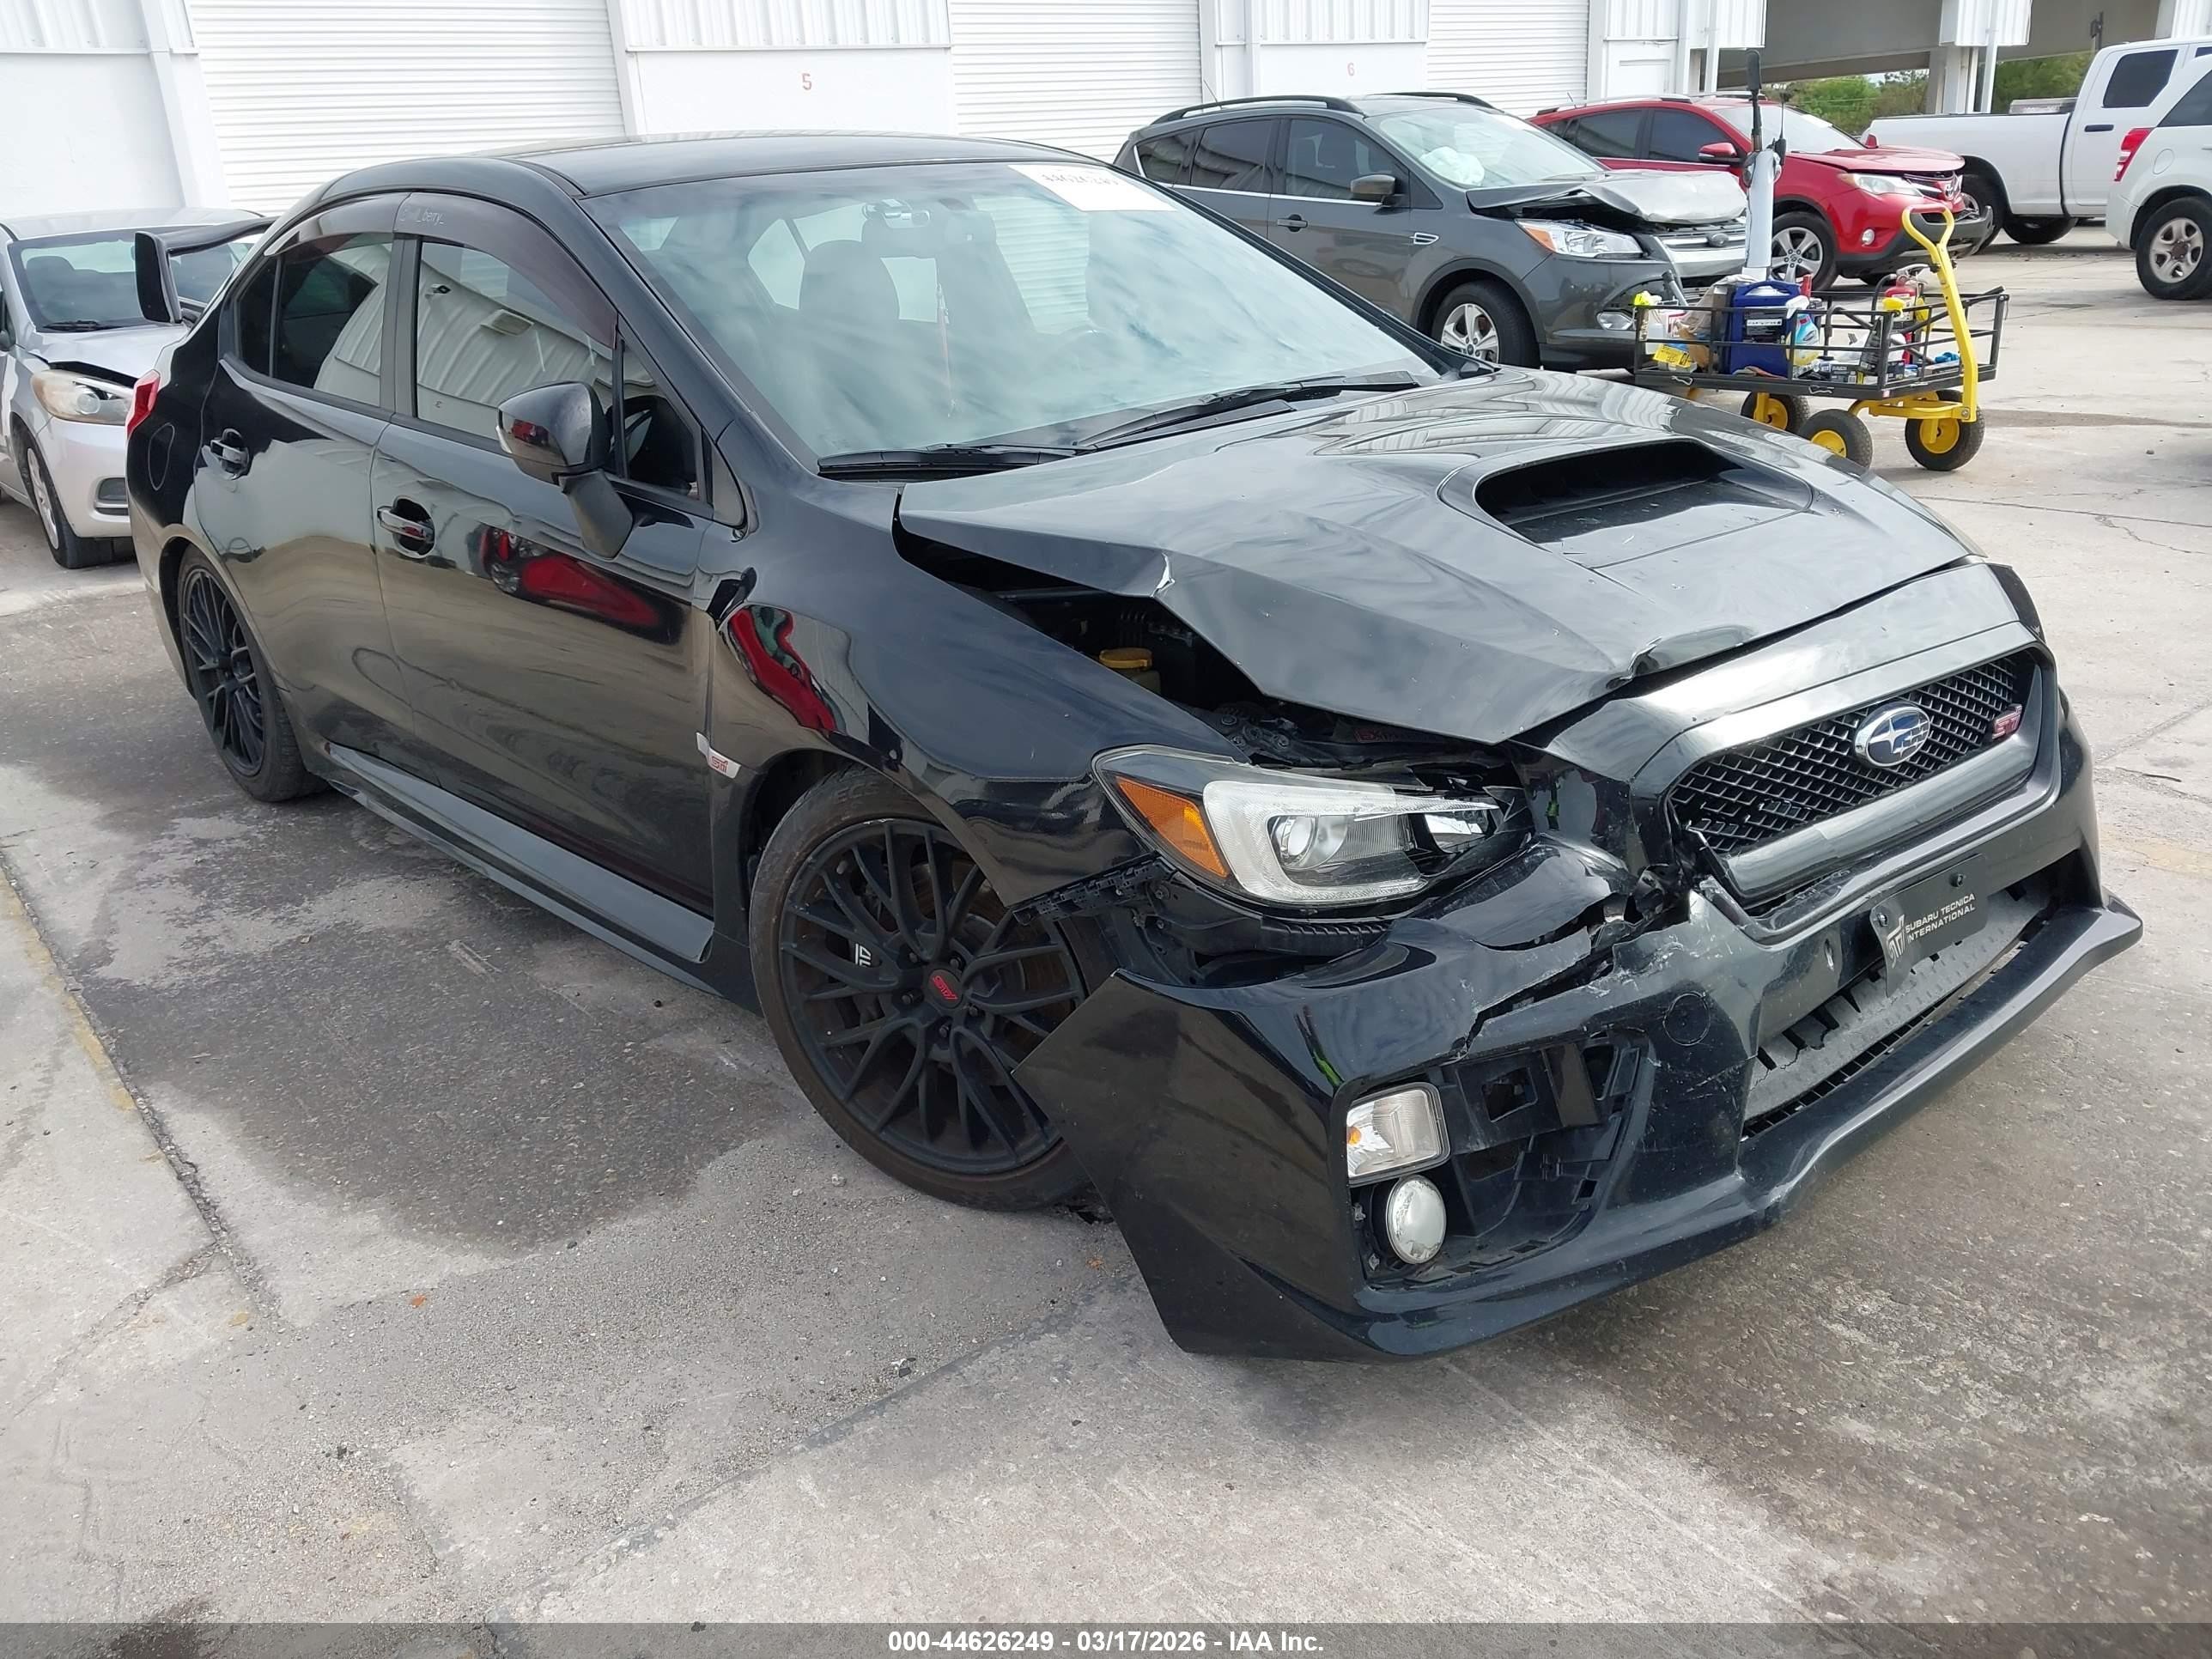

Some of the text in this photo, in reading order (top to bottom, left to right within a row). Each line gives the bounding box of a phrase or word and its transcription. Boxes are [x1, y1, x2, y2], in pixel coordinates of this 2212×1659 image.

[801, 72, 812, 91] 5
[1347, 62, 1355, 76] 6
[1905, 893, 1976, 934] SUBARU TECNICA
[1907, 903, 1976, 945] INTERNATIONAL
